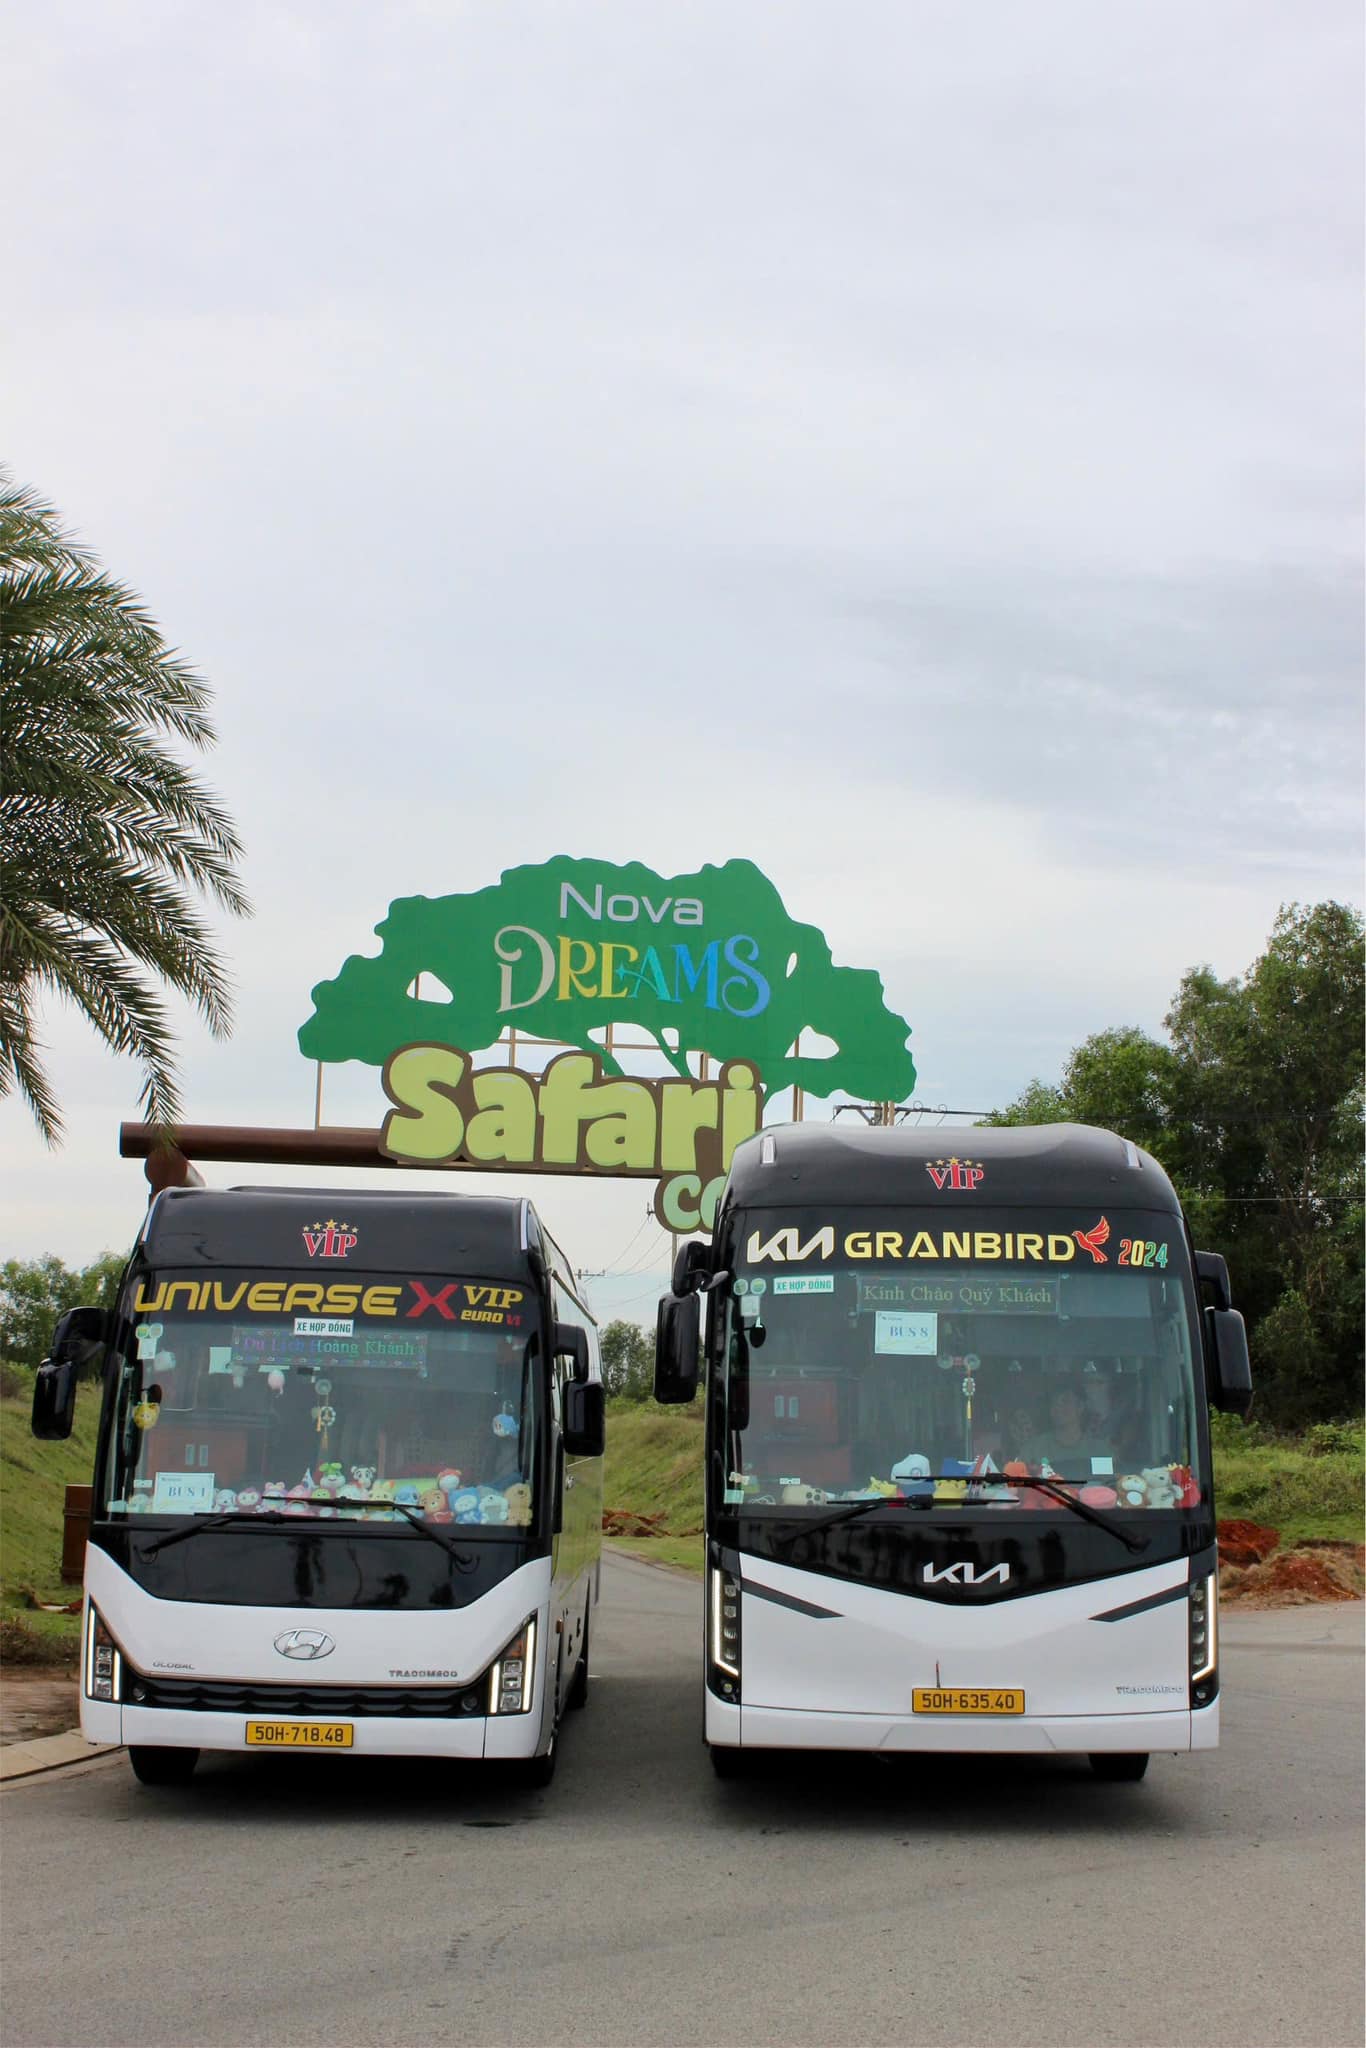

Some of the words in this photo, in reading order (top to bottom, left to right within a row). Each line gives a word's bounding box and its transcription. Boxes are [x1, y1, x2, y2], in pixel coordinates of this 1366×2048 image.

[559, 882, 704, 926] Nova
[494, 925, 771, 1018] DREAMS
[385, 1046, 758, 1173] Safari
[925, 1164, 984, 1190] VIP
[302, 1229, 358, 1257] VIP
[746, 1226, 835, 1263] KIA
[844, 1231, 1075, 1262] GRANBIRD
[1118, 1239, 1169, 1269] 2024
[134, 1281, 402, 1316] UNIVERSE
[405, 1281, 458, 1320] X
[463, 1285, 523, 1309] VIP
[296, 1321, 307, 1331] XE
[922, 1693, 1015, 1709] 50H-635.40
[255, 1725, 344, 1743] 50H-718.48
